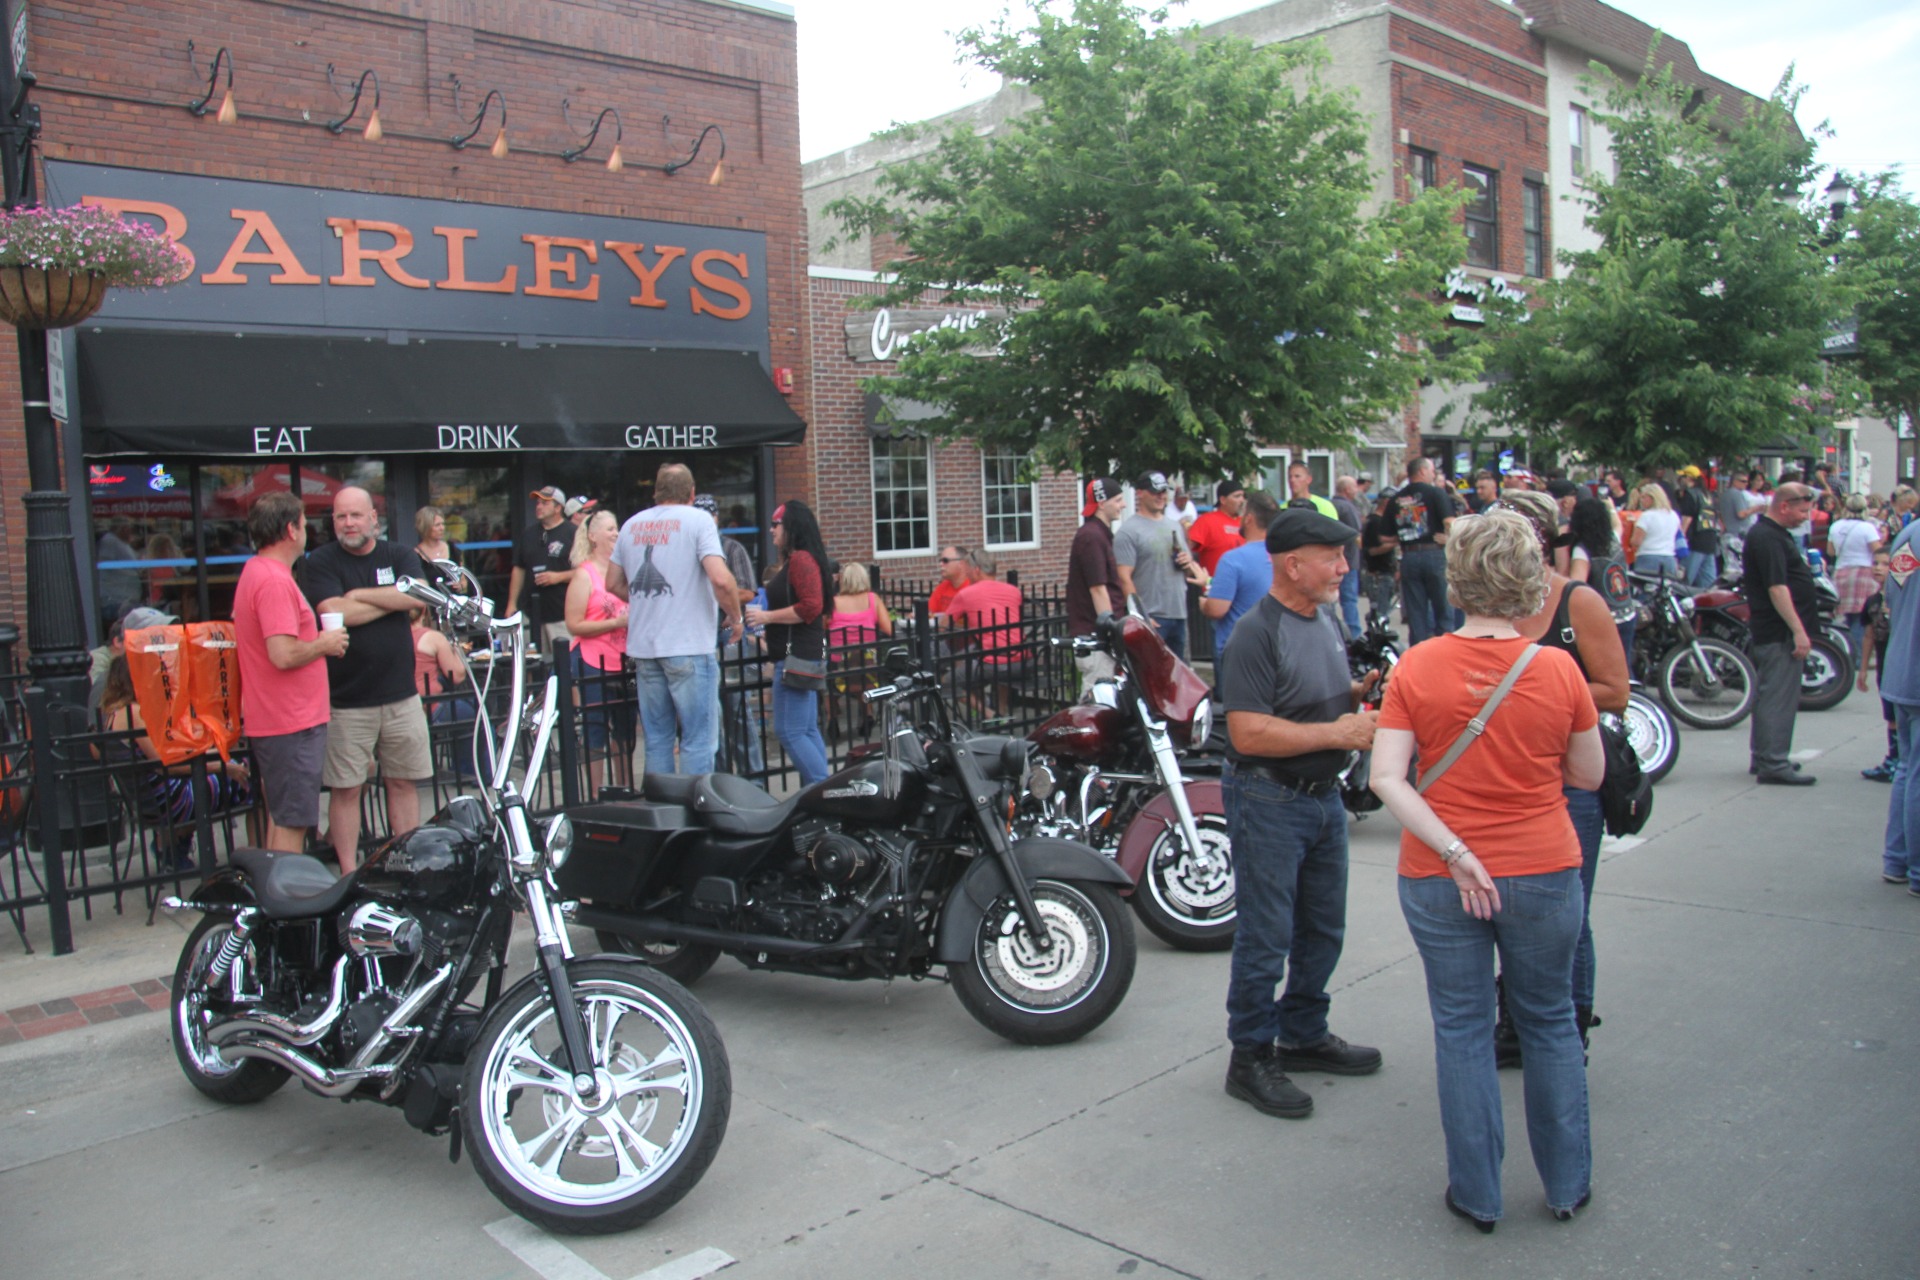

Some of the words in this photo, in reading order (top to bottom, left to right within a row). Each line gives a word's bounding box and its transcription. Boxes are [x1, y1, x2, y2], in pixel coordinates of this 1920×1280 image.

[81, 195, 752, 320] BARLEYS
[253, 426, 312, 453] EAT
[437, 424, 521, 450] DRINK
[625, 425, 718, 448] GATHER
[633, 533, 670, 545] DOWN
[151, 634, 165, 644] NO
[210, 631, 226, 641] NO
